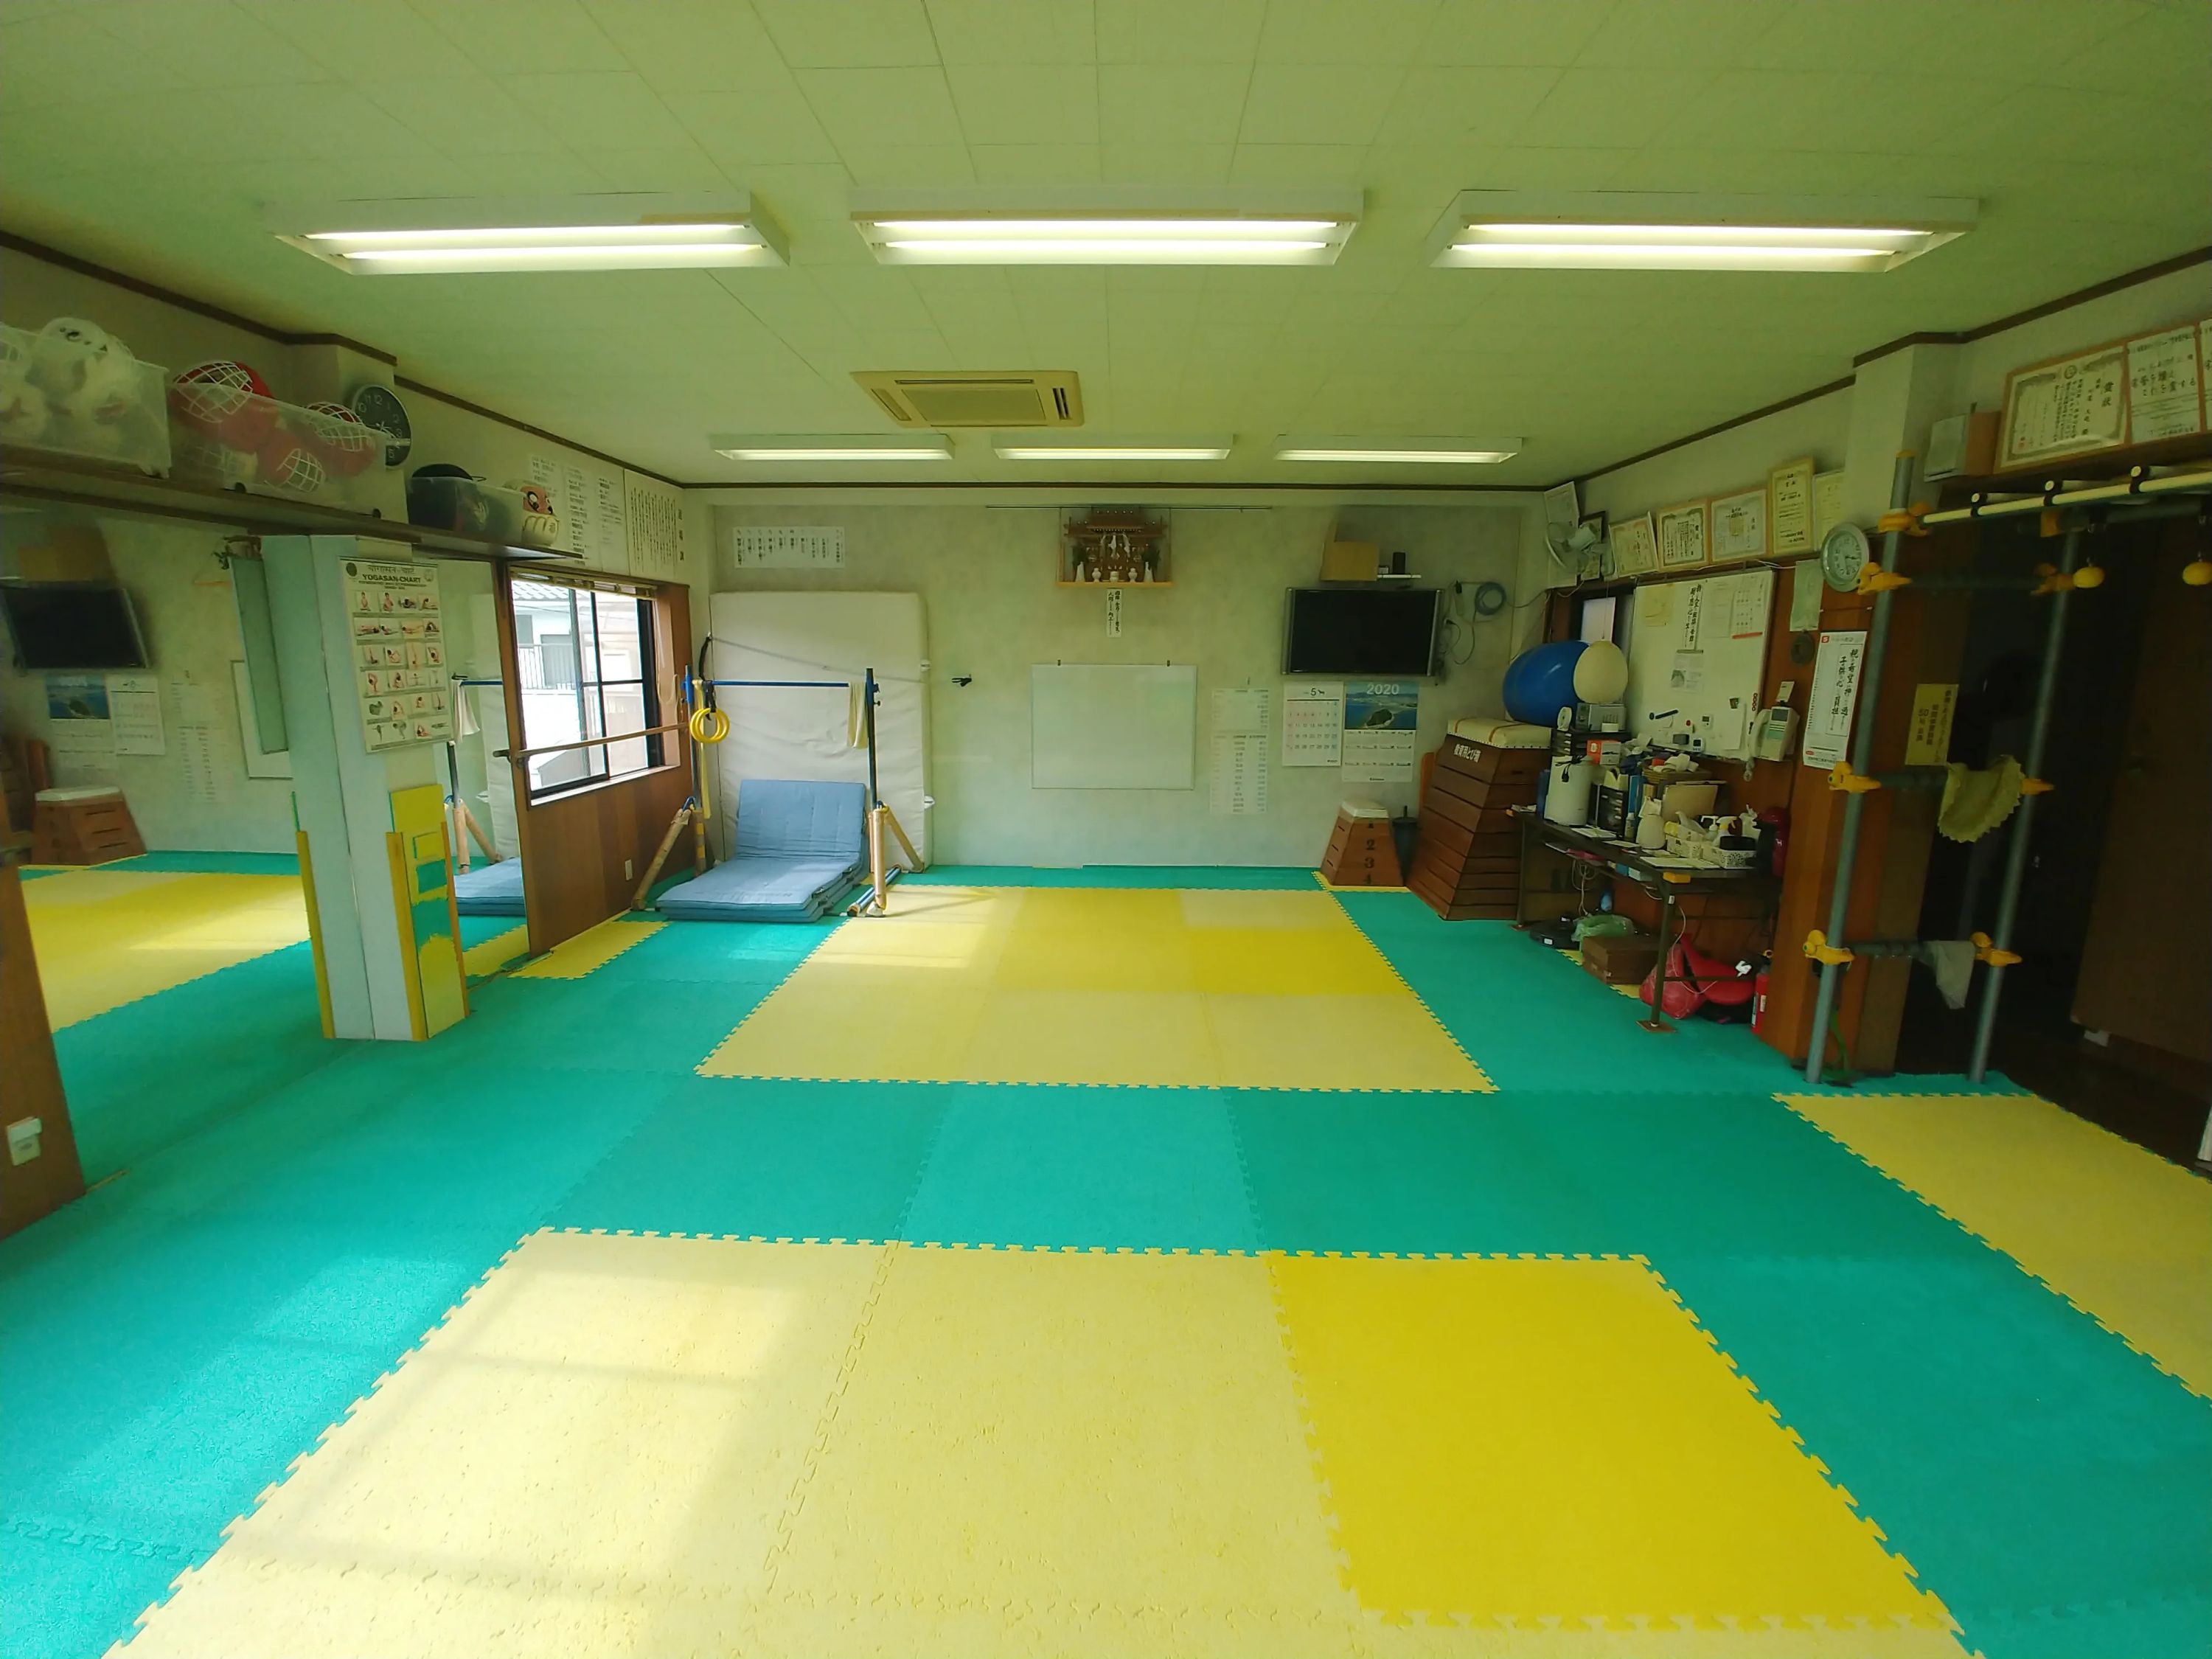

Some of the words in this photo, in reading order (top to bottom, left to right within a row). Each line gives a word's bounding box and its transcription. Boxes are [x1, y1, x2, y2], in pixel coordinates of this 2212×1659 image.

[1310, 687, 1316, 696] 5
[1366, 684, 1399, 695] 2020
[1366, 839, 1375, 850] 2
[1364, 858, 1374, 869] 3
